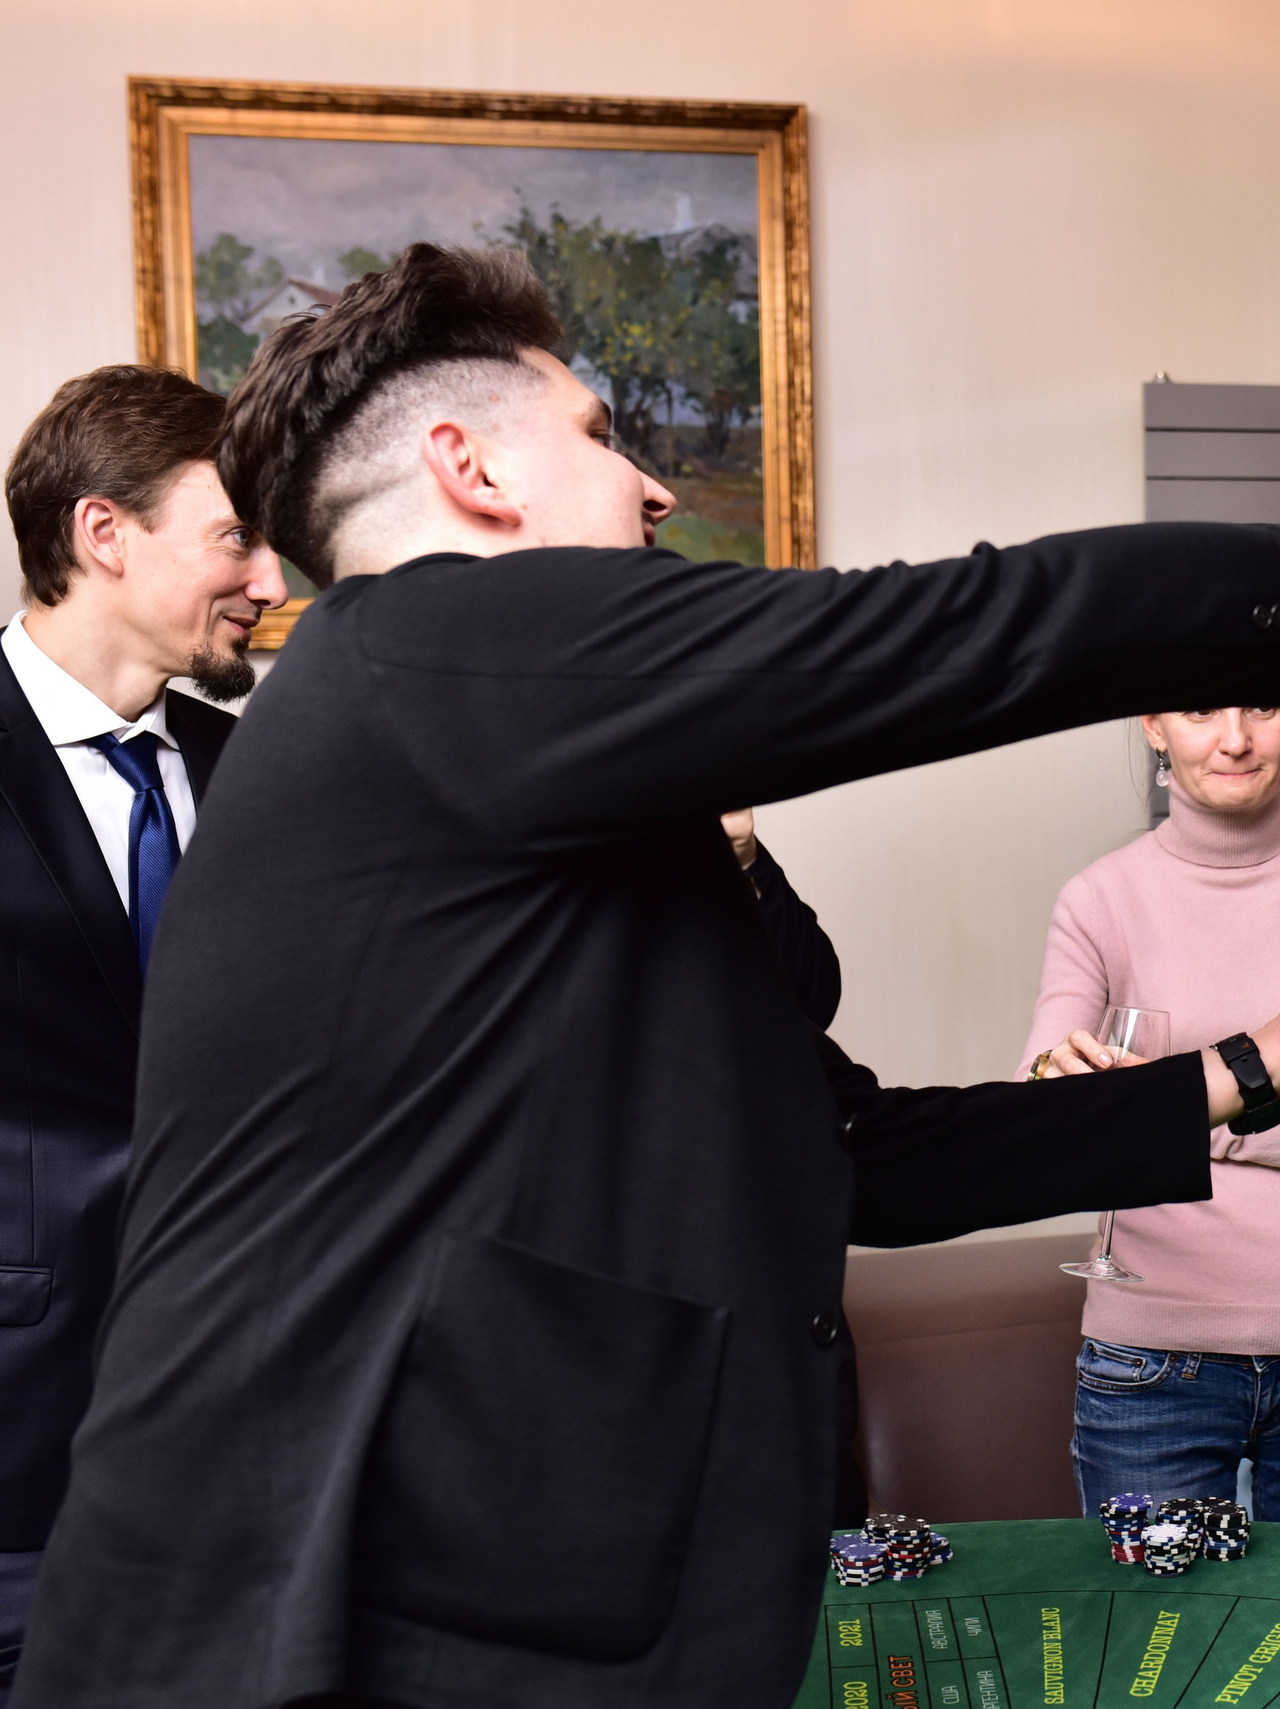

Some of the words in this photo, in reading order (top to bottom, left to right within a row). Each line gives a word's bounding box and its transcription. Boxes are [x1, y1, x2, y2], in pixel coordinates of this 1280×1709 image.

[839, 1618, 864, 1647] 2021
[964, 1617, 984, 1636] ЧИЛИ
[1041, 1607, 1062, 1641] BLANC
[1129, 1610, 1181, 1698] CHARDONNAY
[888, 1655, 917, 1688] СВЕТ
[1043, 1642, 1064, 1705] SAUVIGNON
[1214, 1664, 1264, 1705] PINOT
[941, 1685, 960, 1705] США
[977, 1670, 1000, 1709] РГЕНТИНА
